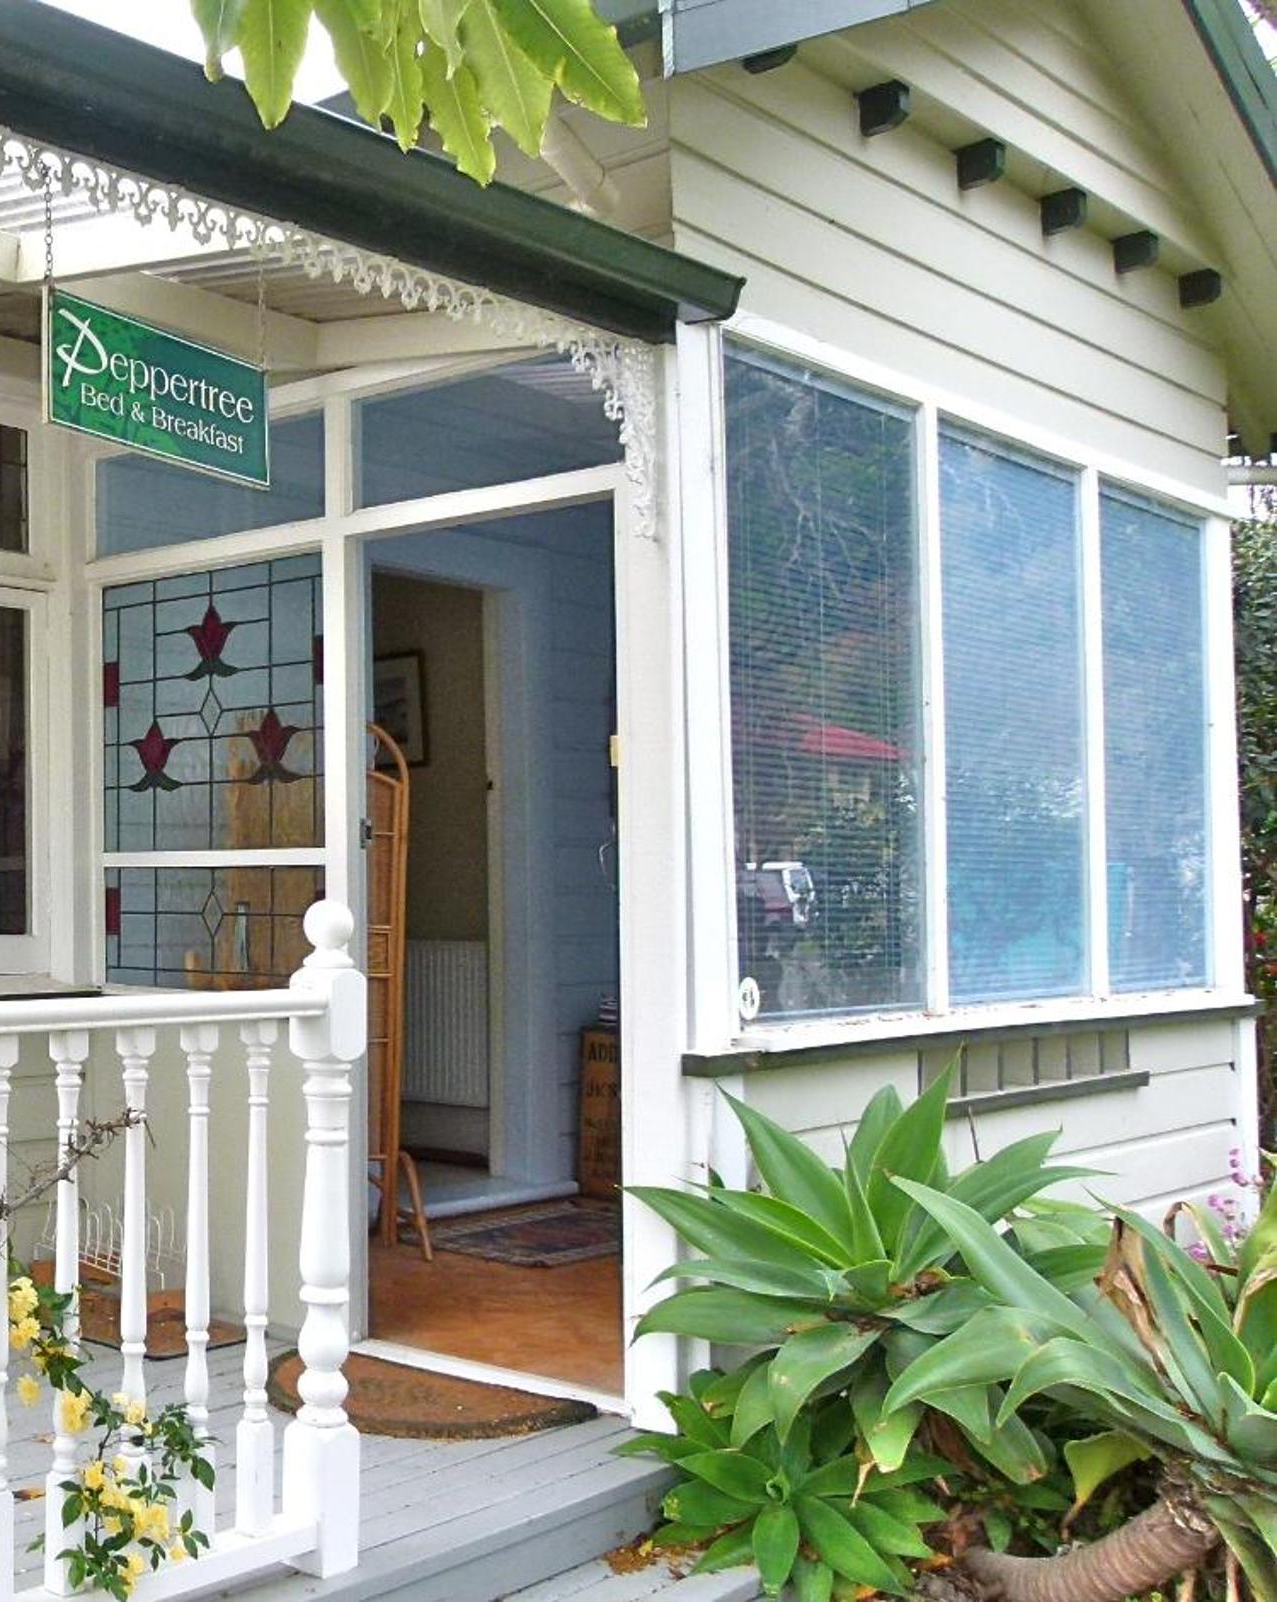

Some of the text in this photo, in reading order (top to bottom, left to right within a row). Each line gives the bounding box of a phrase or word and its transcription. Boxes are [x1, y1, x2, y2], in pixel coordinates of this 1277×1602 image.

[56, 308, 255, 423] Peppertree
[80, 383, 245, 454] Bed & Breakfast
